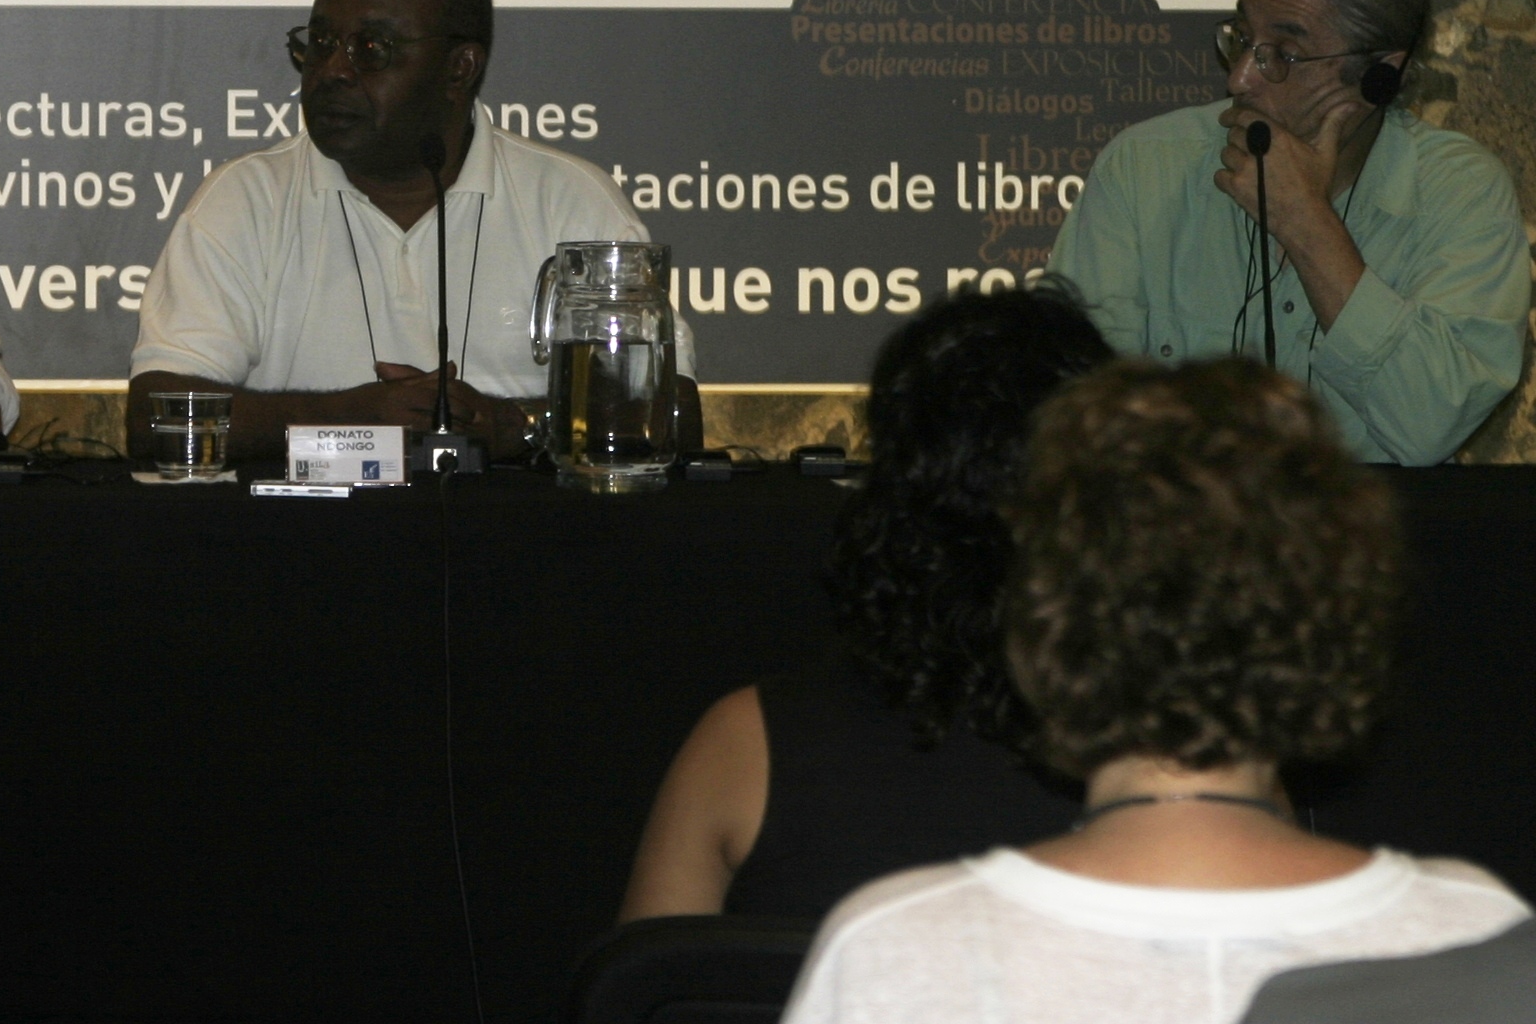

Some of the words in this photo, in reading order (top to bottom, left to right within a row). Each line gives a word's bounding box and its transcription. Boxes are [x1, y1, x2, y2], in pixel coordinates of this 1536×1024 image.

[791, 14, 1030, 44] Presentaciones
[1036, 15, 1077, 45] de
[1083, 16, 1172, 45] libros
[819, 44, 989, 81] Conferencias
[964, 86, 1094, 120] Diálogos
[1100, 78, 1214, 104] Talleres
[153, 172, 184, 221] y
[869, 162, 936, 211] de
[957, 162, 1087, 212] libro
[797, 265, 922, 314] nos
[317, 430, 374, 440] DONATO
